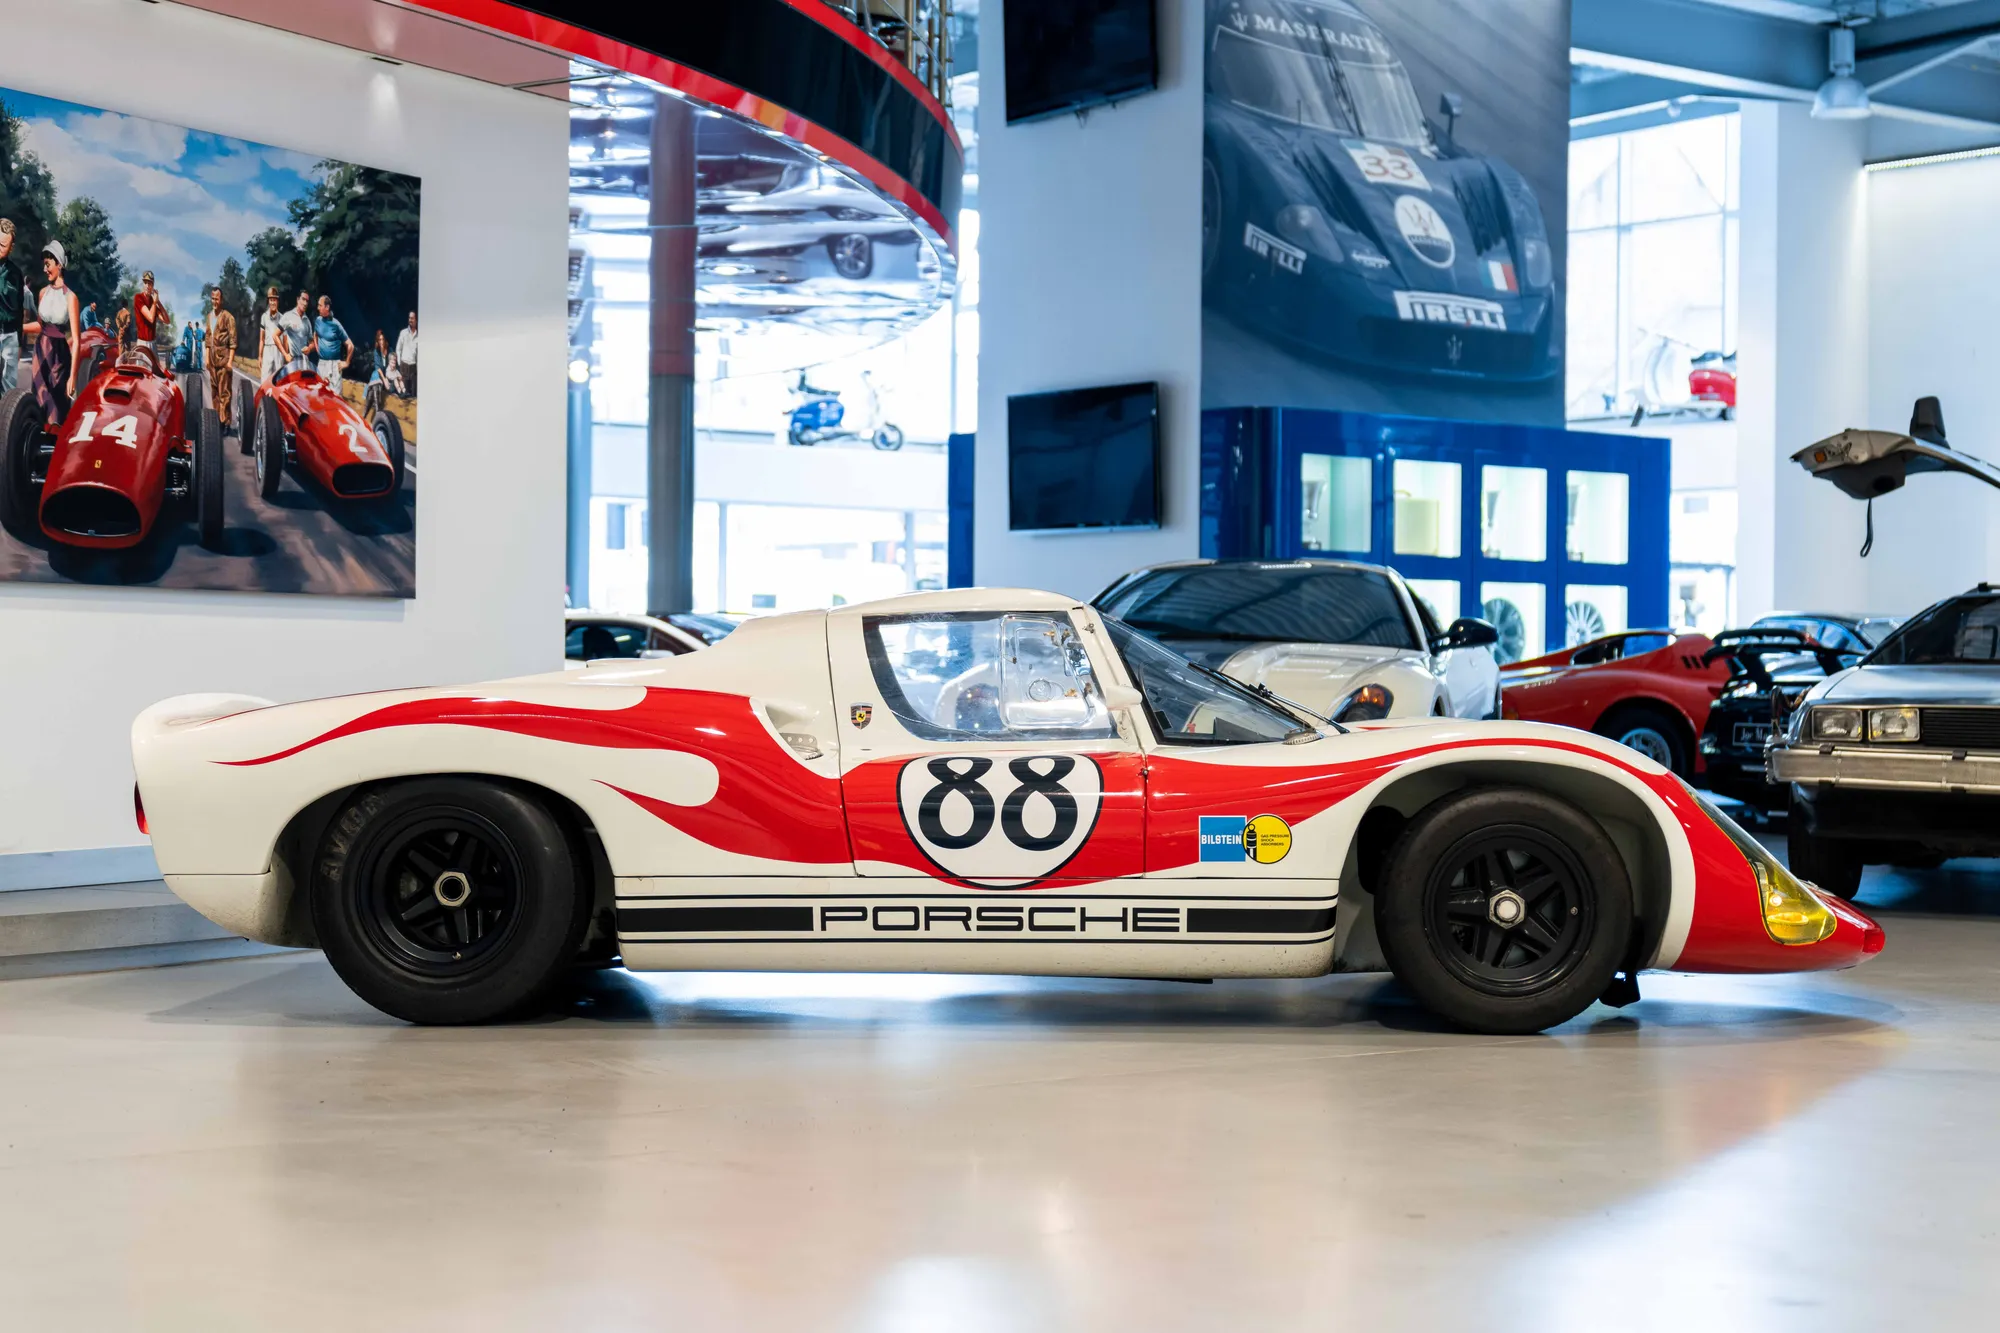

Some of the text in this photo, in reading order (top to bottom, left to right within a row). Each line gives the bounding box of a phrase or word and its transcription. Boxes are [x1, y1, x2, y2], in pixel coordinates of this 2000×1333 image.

[1253, 13, 1376, 54] MASERATI
[1361, 155, 1414, 180] 33
[1244, 221, 1307, 275] PIRLLI
[1393, 290, 1508, 332] PIRELLI
[68, 411, 138, 449] 14
[338, 423, 369, 453] 2
[917, 754, 1079, 852] 88
[1200, 834, 1242, 845] BILSTEIN
[820, 905, 1180, 932] PORSCHE
